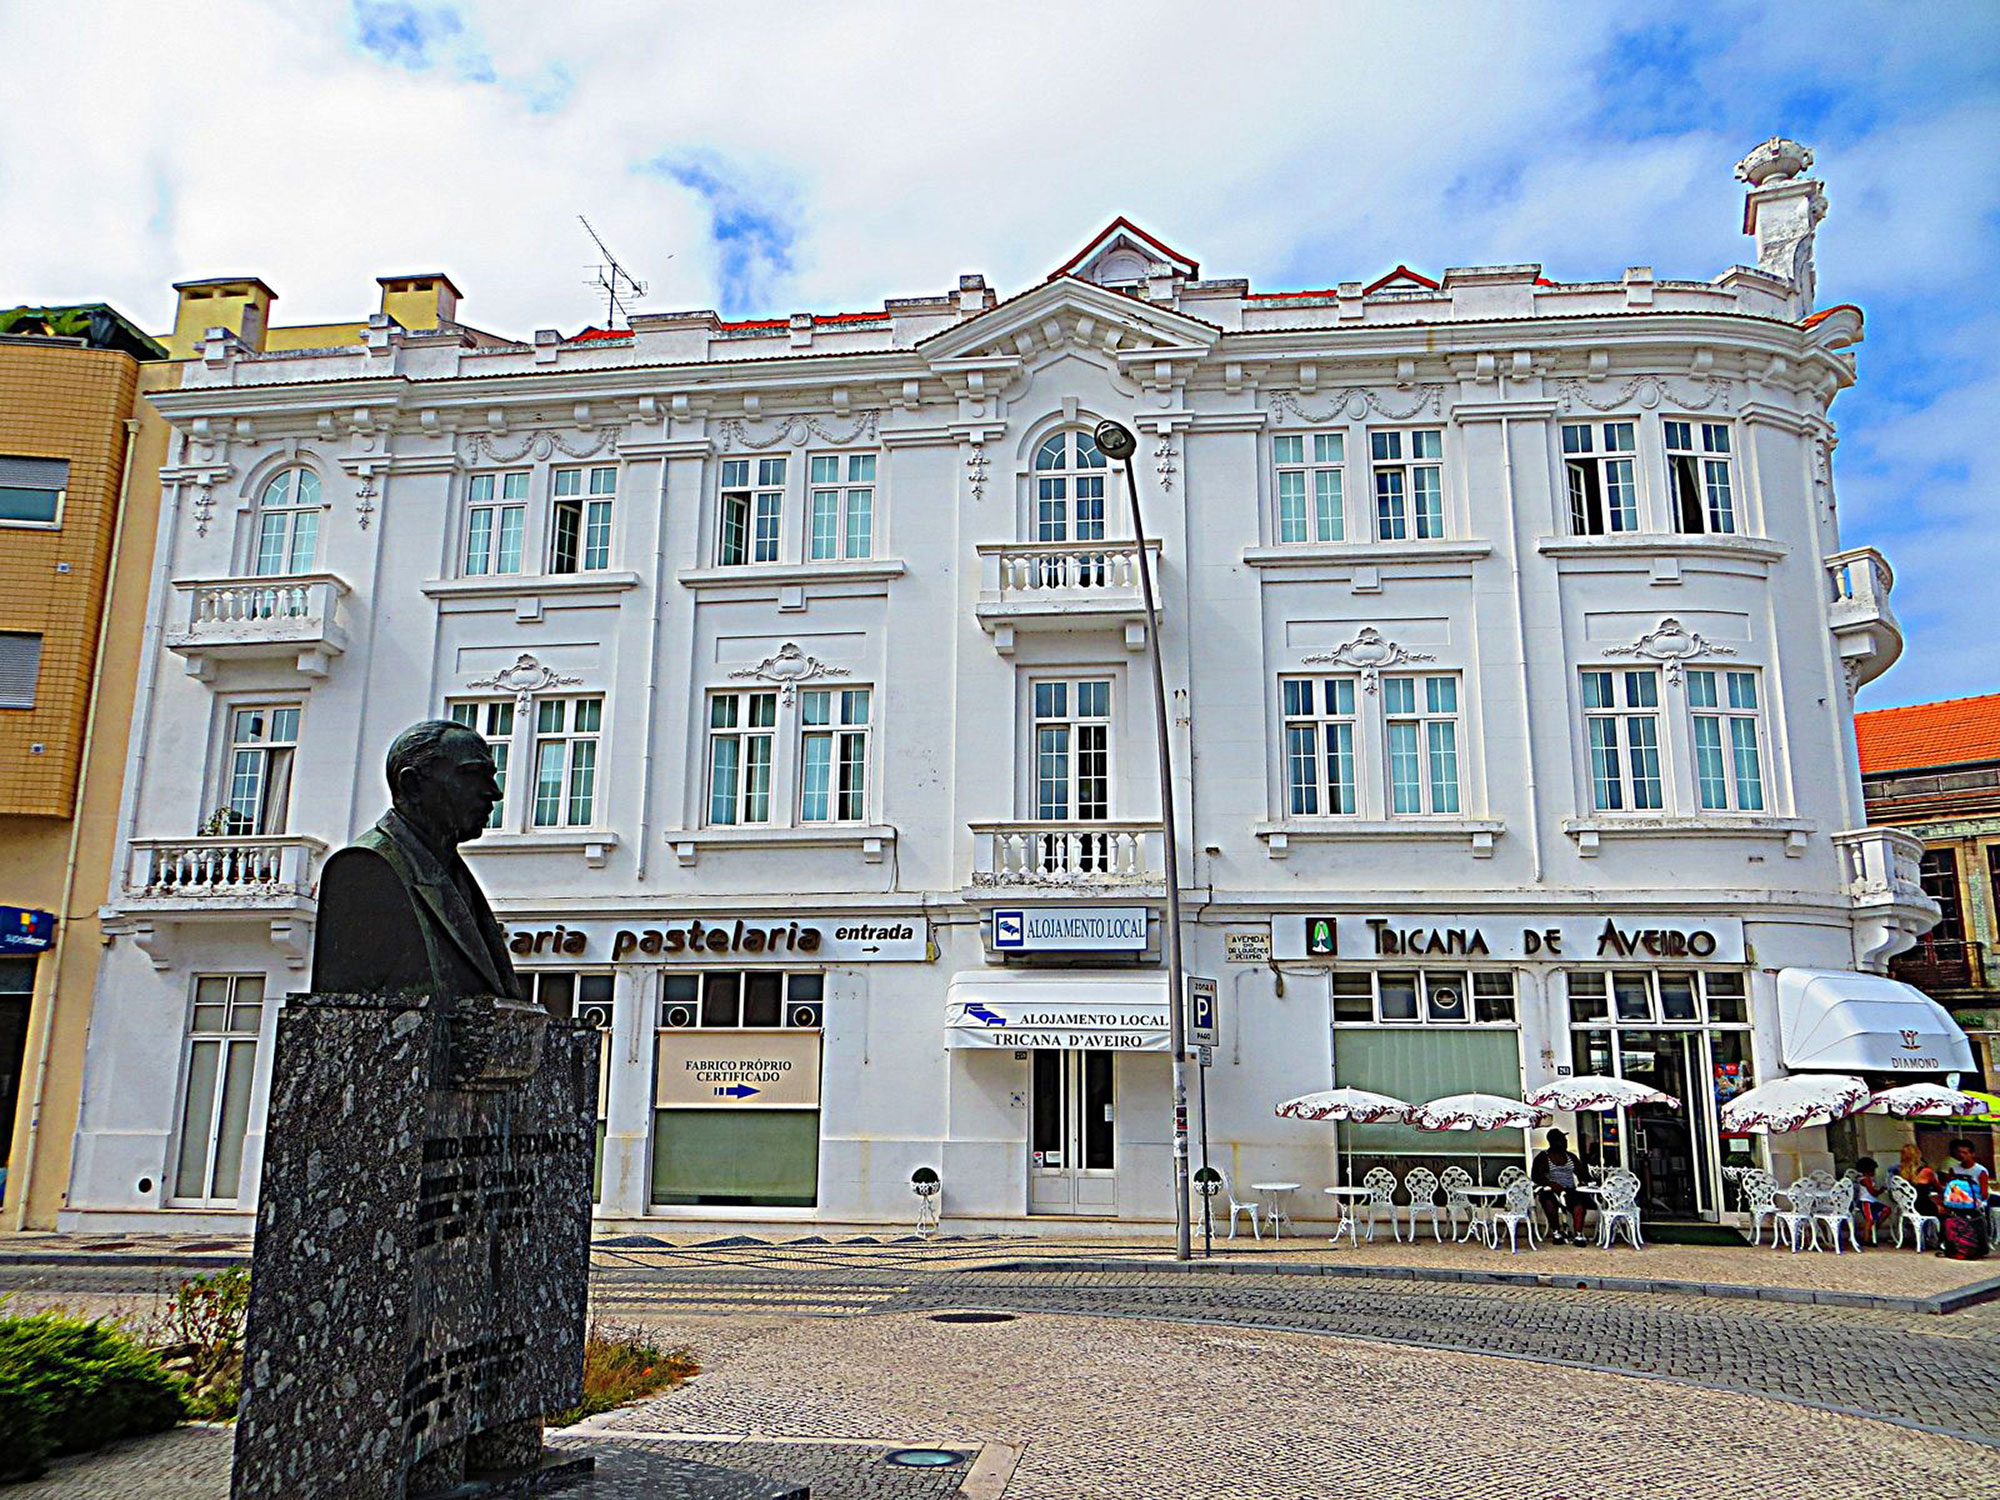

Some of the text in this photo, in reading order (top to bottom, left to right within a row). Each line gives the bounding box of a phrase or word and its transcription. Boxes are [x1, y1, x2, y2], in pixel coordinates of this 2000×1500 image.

[835, 924, 913, 940] entrada
[1027, 918, 1145, 938] ALOJAMENTO LOCAL
[611, 920, 821, 961] pastelaria
[1523, 929, 1562, 955] DE
[1197, 998, 1208, 1025] P
[1020, 1013, 1169, 1027] ALOJAMENTO LOCAL
[993, 1033, 1142, 1047] TRICANA D'AVEIRO
[685, 1058, 792, 1071] FABRICO PRÓPRIO
[1891, 1057, 1939, 1069] DIAMOND
[696, 1071, 780, 1082] CERTIFICADO
